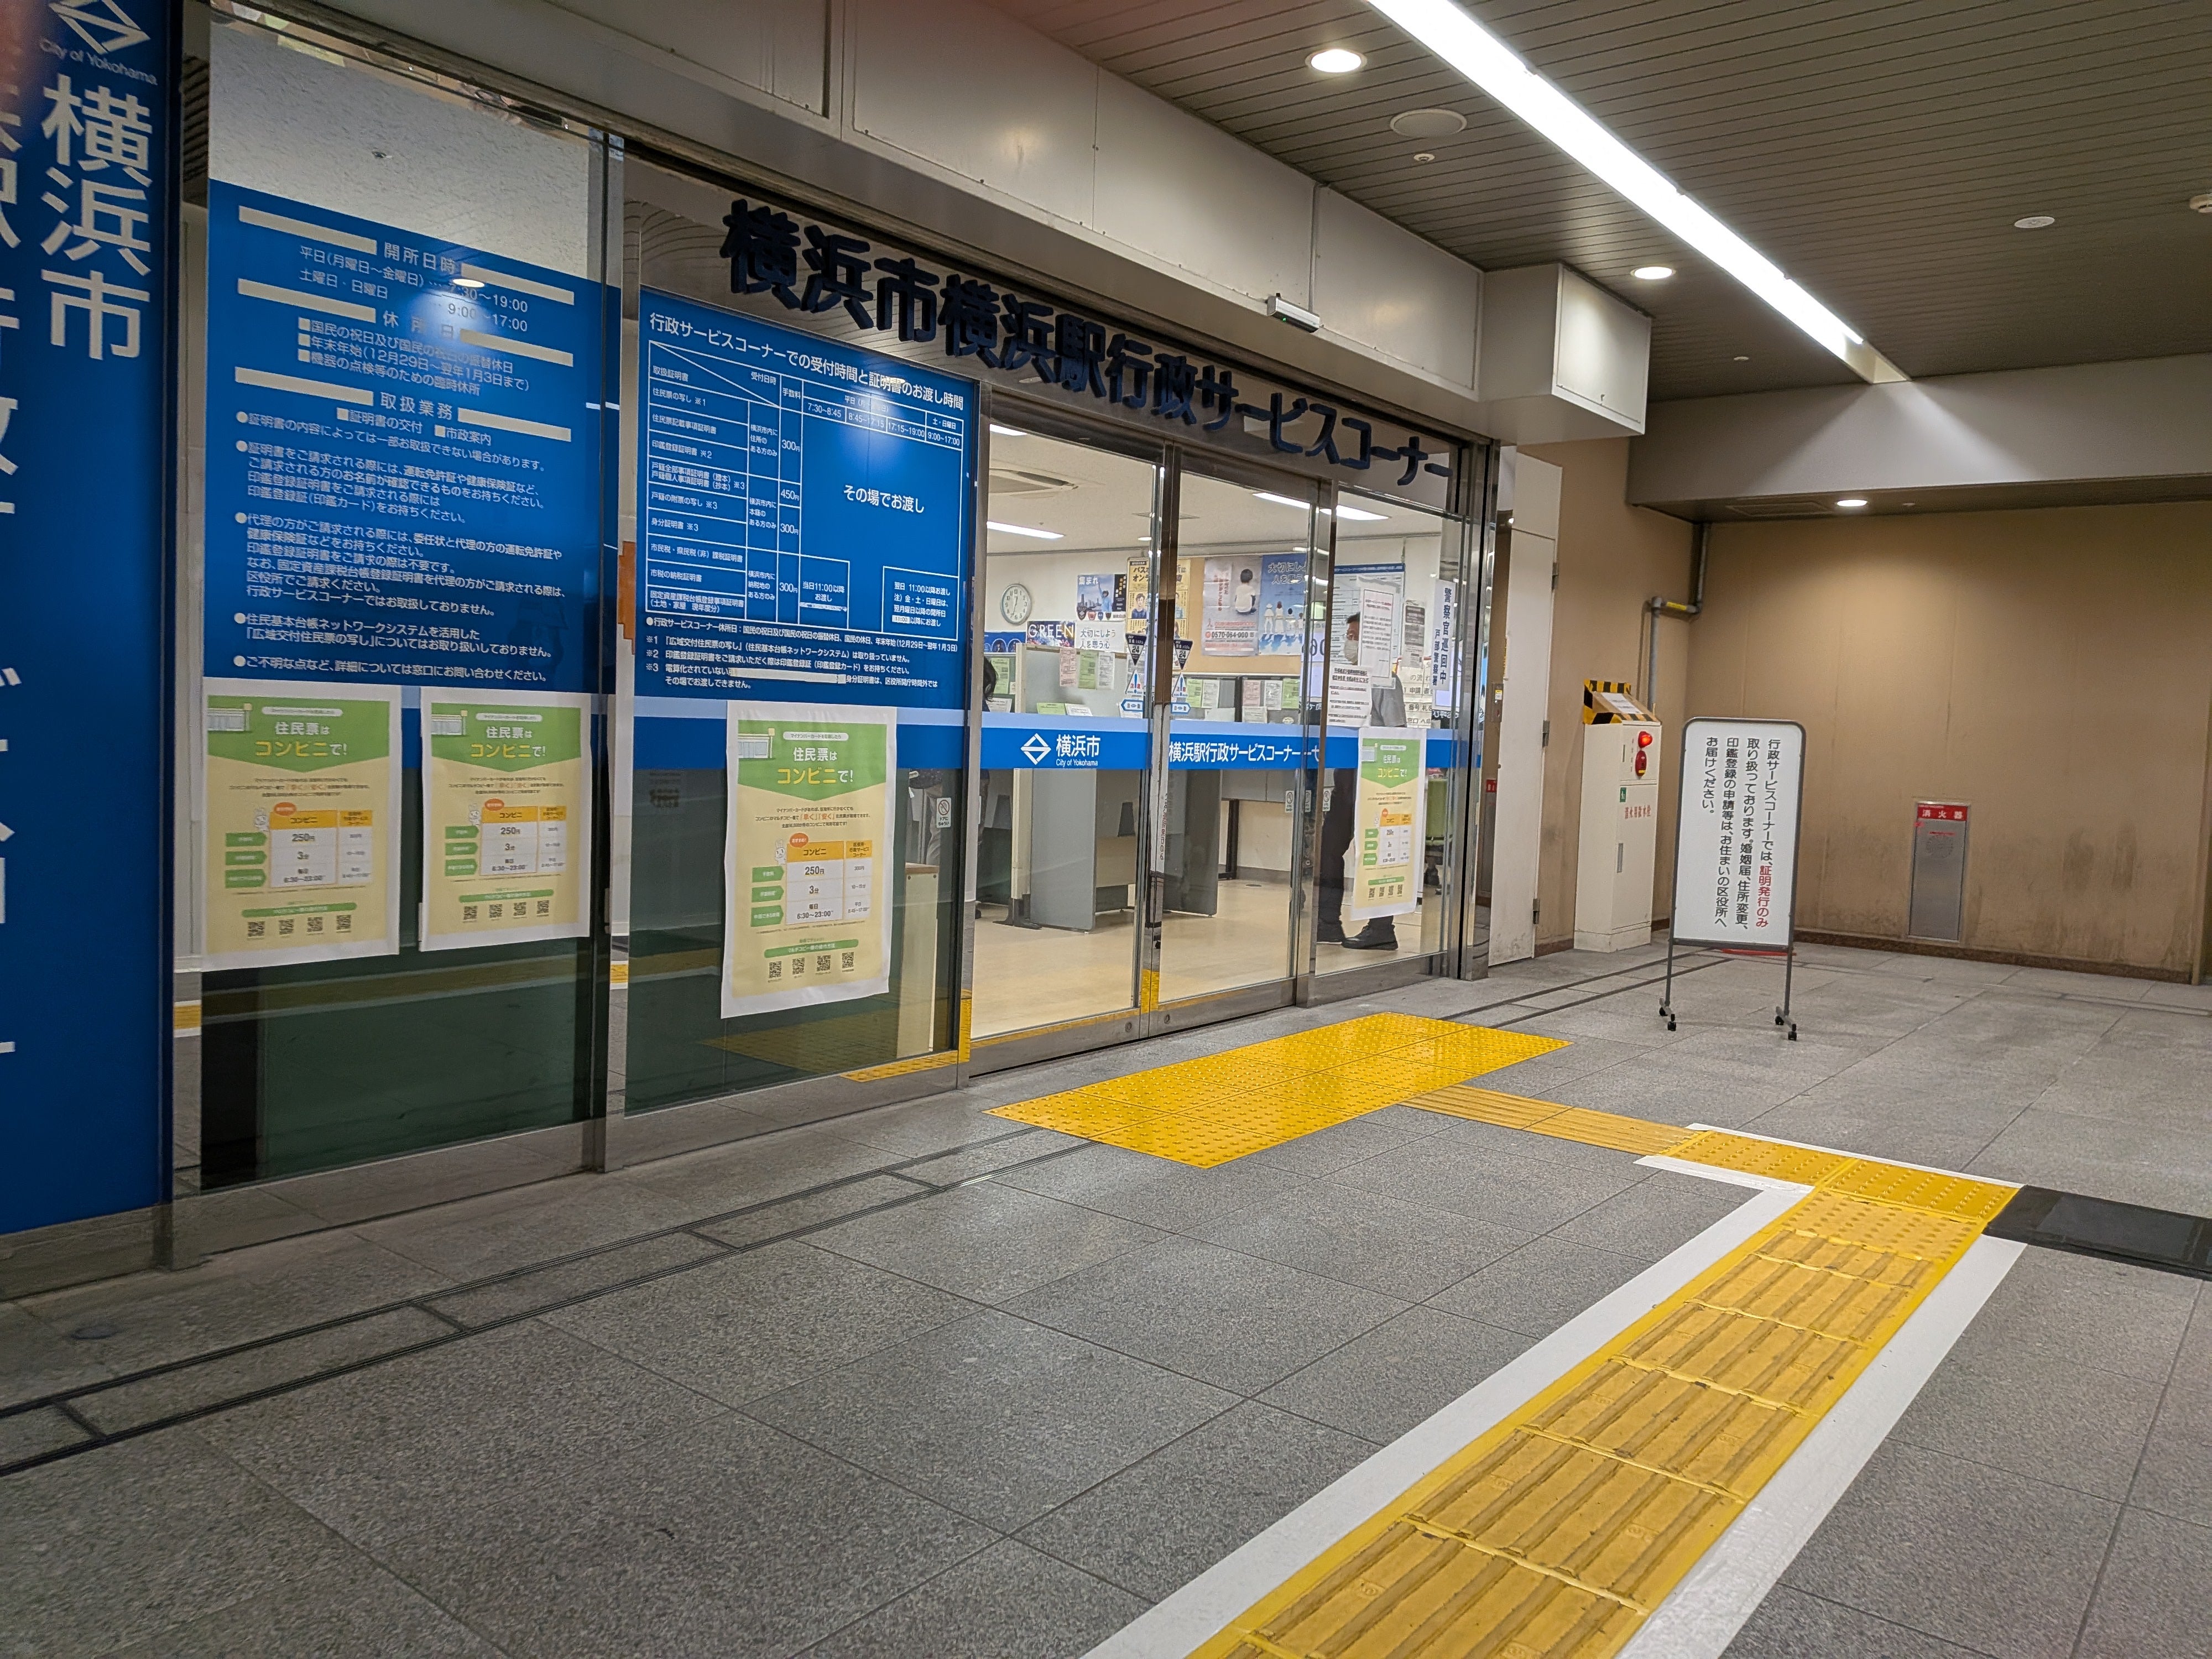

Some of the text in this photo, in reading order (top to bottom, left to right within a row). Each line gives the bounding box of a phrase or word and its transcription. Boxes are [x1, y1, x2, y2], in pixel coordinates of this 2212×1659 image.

[41, 72, 152, 361] 横浜市
[384, 241, 456, 275] 開所日時
[719, 198, 1453, 486] 横浜市横浜駅行政サービスコーナー
[649, 312, 964, 411] 行政サービスコーナーでの受付時間と証明書のお渡し時間
[751, 371, 776, 385] 受付日時
[782, 388, 801, 399] 手数料
[380, 392, 452, 420] 取扱業務
[349, 409, 492, 446] 証明書の交付 市政案内
[932, 417, 956, 430] 土・日曜日
[781, 440, 800, 452] 300円
[780, 489, 800, 501] 450円
[843, 484, 925, 514] その場でお渡し
[780, 524, 799, 535] 300円
[779, 582, 798, 593] 300円
[802, 581, 845, 593] 当日11:00以降
[815, 593, 832, 602] お渡し
[1028, 624, 1074, 638] GREEN
[1080, 629, 1116, 638] 大切にしよう
[646, 635, 659, 645] ※1
[1079, 640, 1110, 649] 人を思う心
[646, 649, 659, 659] ※2
[646, 663, 659, 672] ※3
[665, 676, 752, 689] その場でお渡しできません。
[275, 721, 330, 736] 住民票は
[486, 726, 533, 739] 住民票は
[1056, 734, 1101, 758] 横浜市
[1168, 741, 1301, 763] 横浜駅行政サービスコーナー
[793, 747, 838, 762] 住民票は
[1056, 758, 1066, 768] City
[1702, 737, 1718, 813] お届けください。
[1922, 809, 1963, 820] 消火器
[1714, 737, 1739, 927] 印鑑登録の申請等は、お住まいの区役所へ
[1735, 738, 1760, 930] 取り扱っております。婚姻届、住所変更、
[1755, 739, 1781, 927] 行政サービスコーナーでは、証明発行のみ
[803, 848, 827, 857] コンビニ
[805, 865, 825, 875] 250円
[809, 885, 819, 894] 3分
